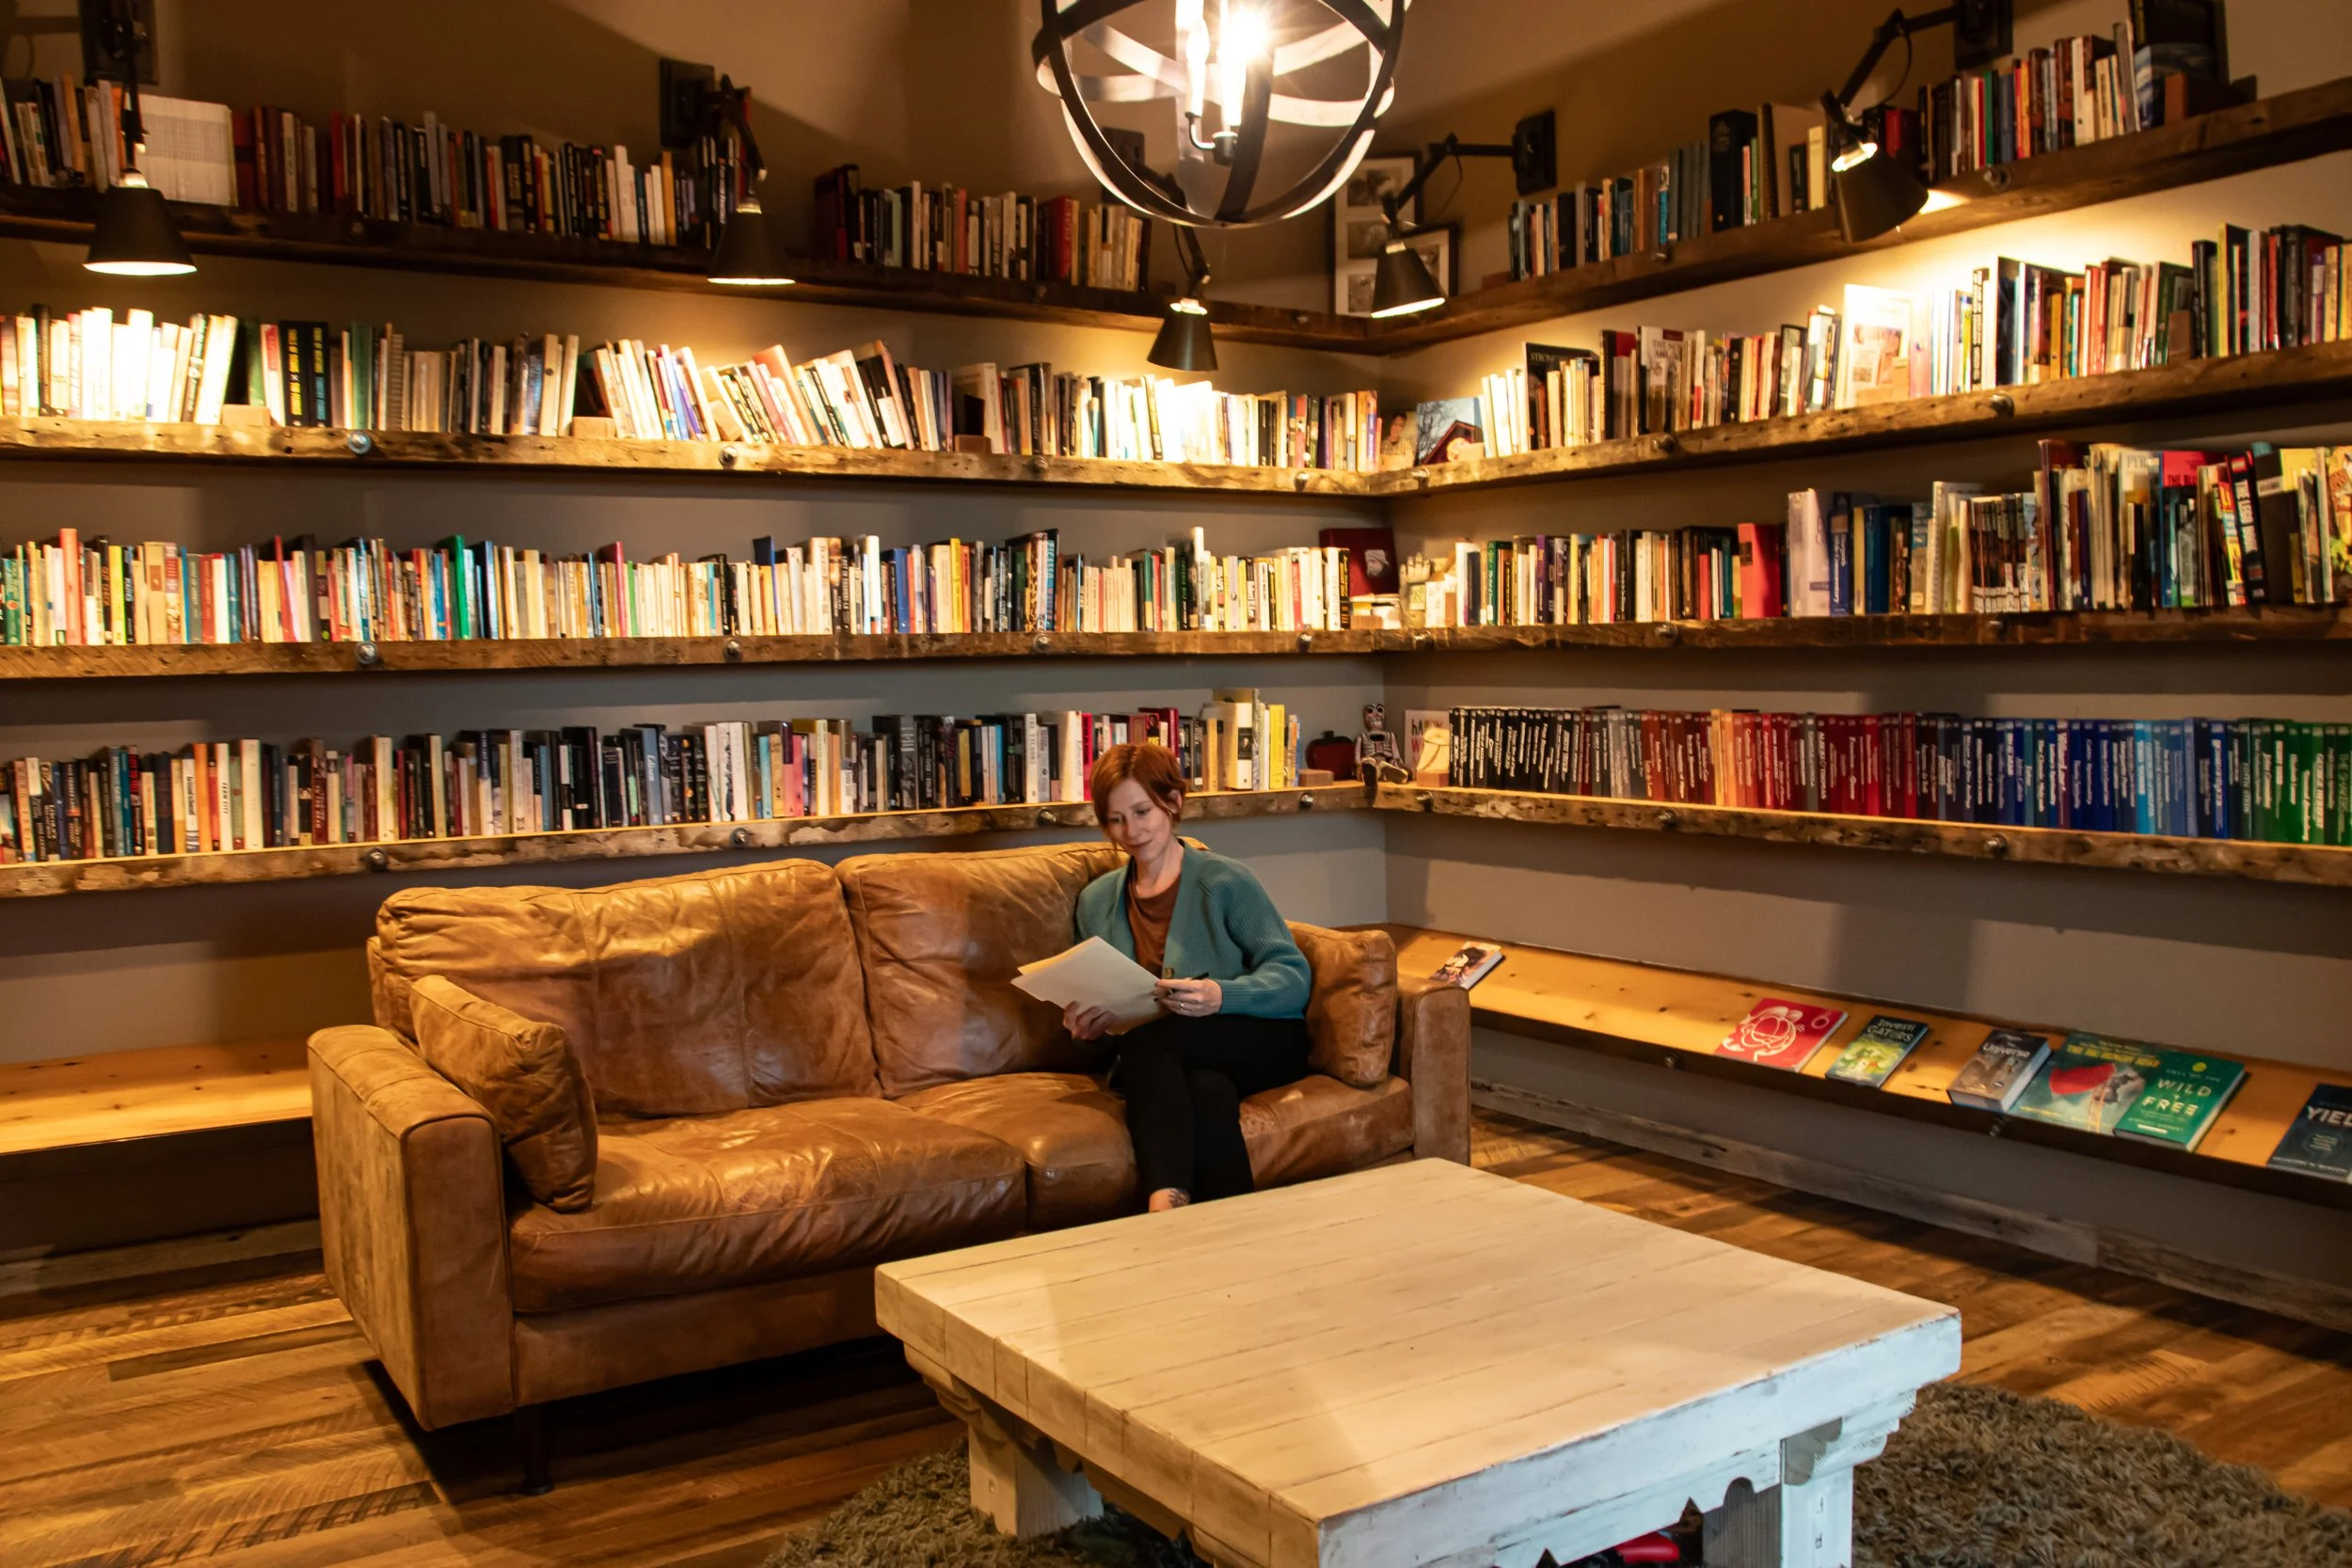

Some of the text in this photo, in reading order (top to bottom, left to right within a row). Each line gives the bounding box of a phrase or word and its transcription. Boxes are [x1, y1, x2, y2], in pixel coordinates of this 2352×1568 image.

[647, 754, 656, 781] Edison
[2339, 753, 2348, 813] THE SHAKERS
[1867, 1025, 1914, 1042] GATORS
[1981, 1043, 2032, 1058] Universe
[2158, 1078, 2212, 1097] WILD
[2141, 1096, 2199, 1117] FREE
